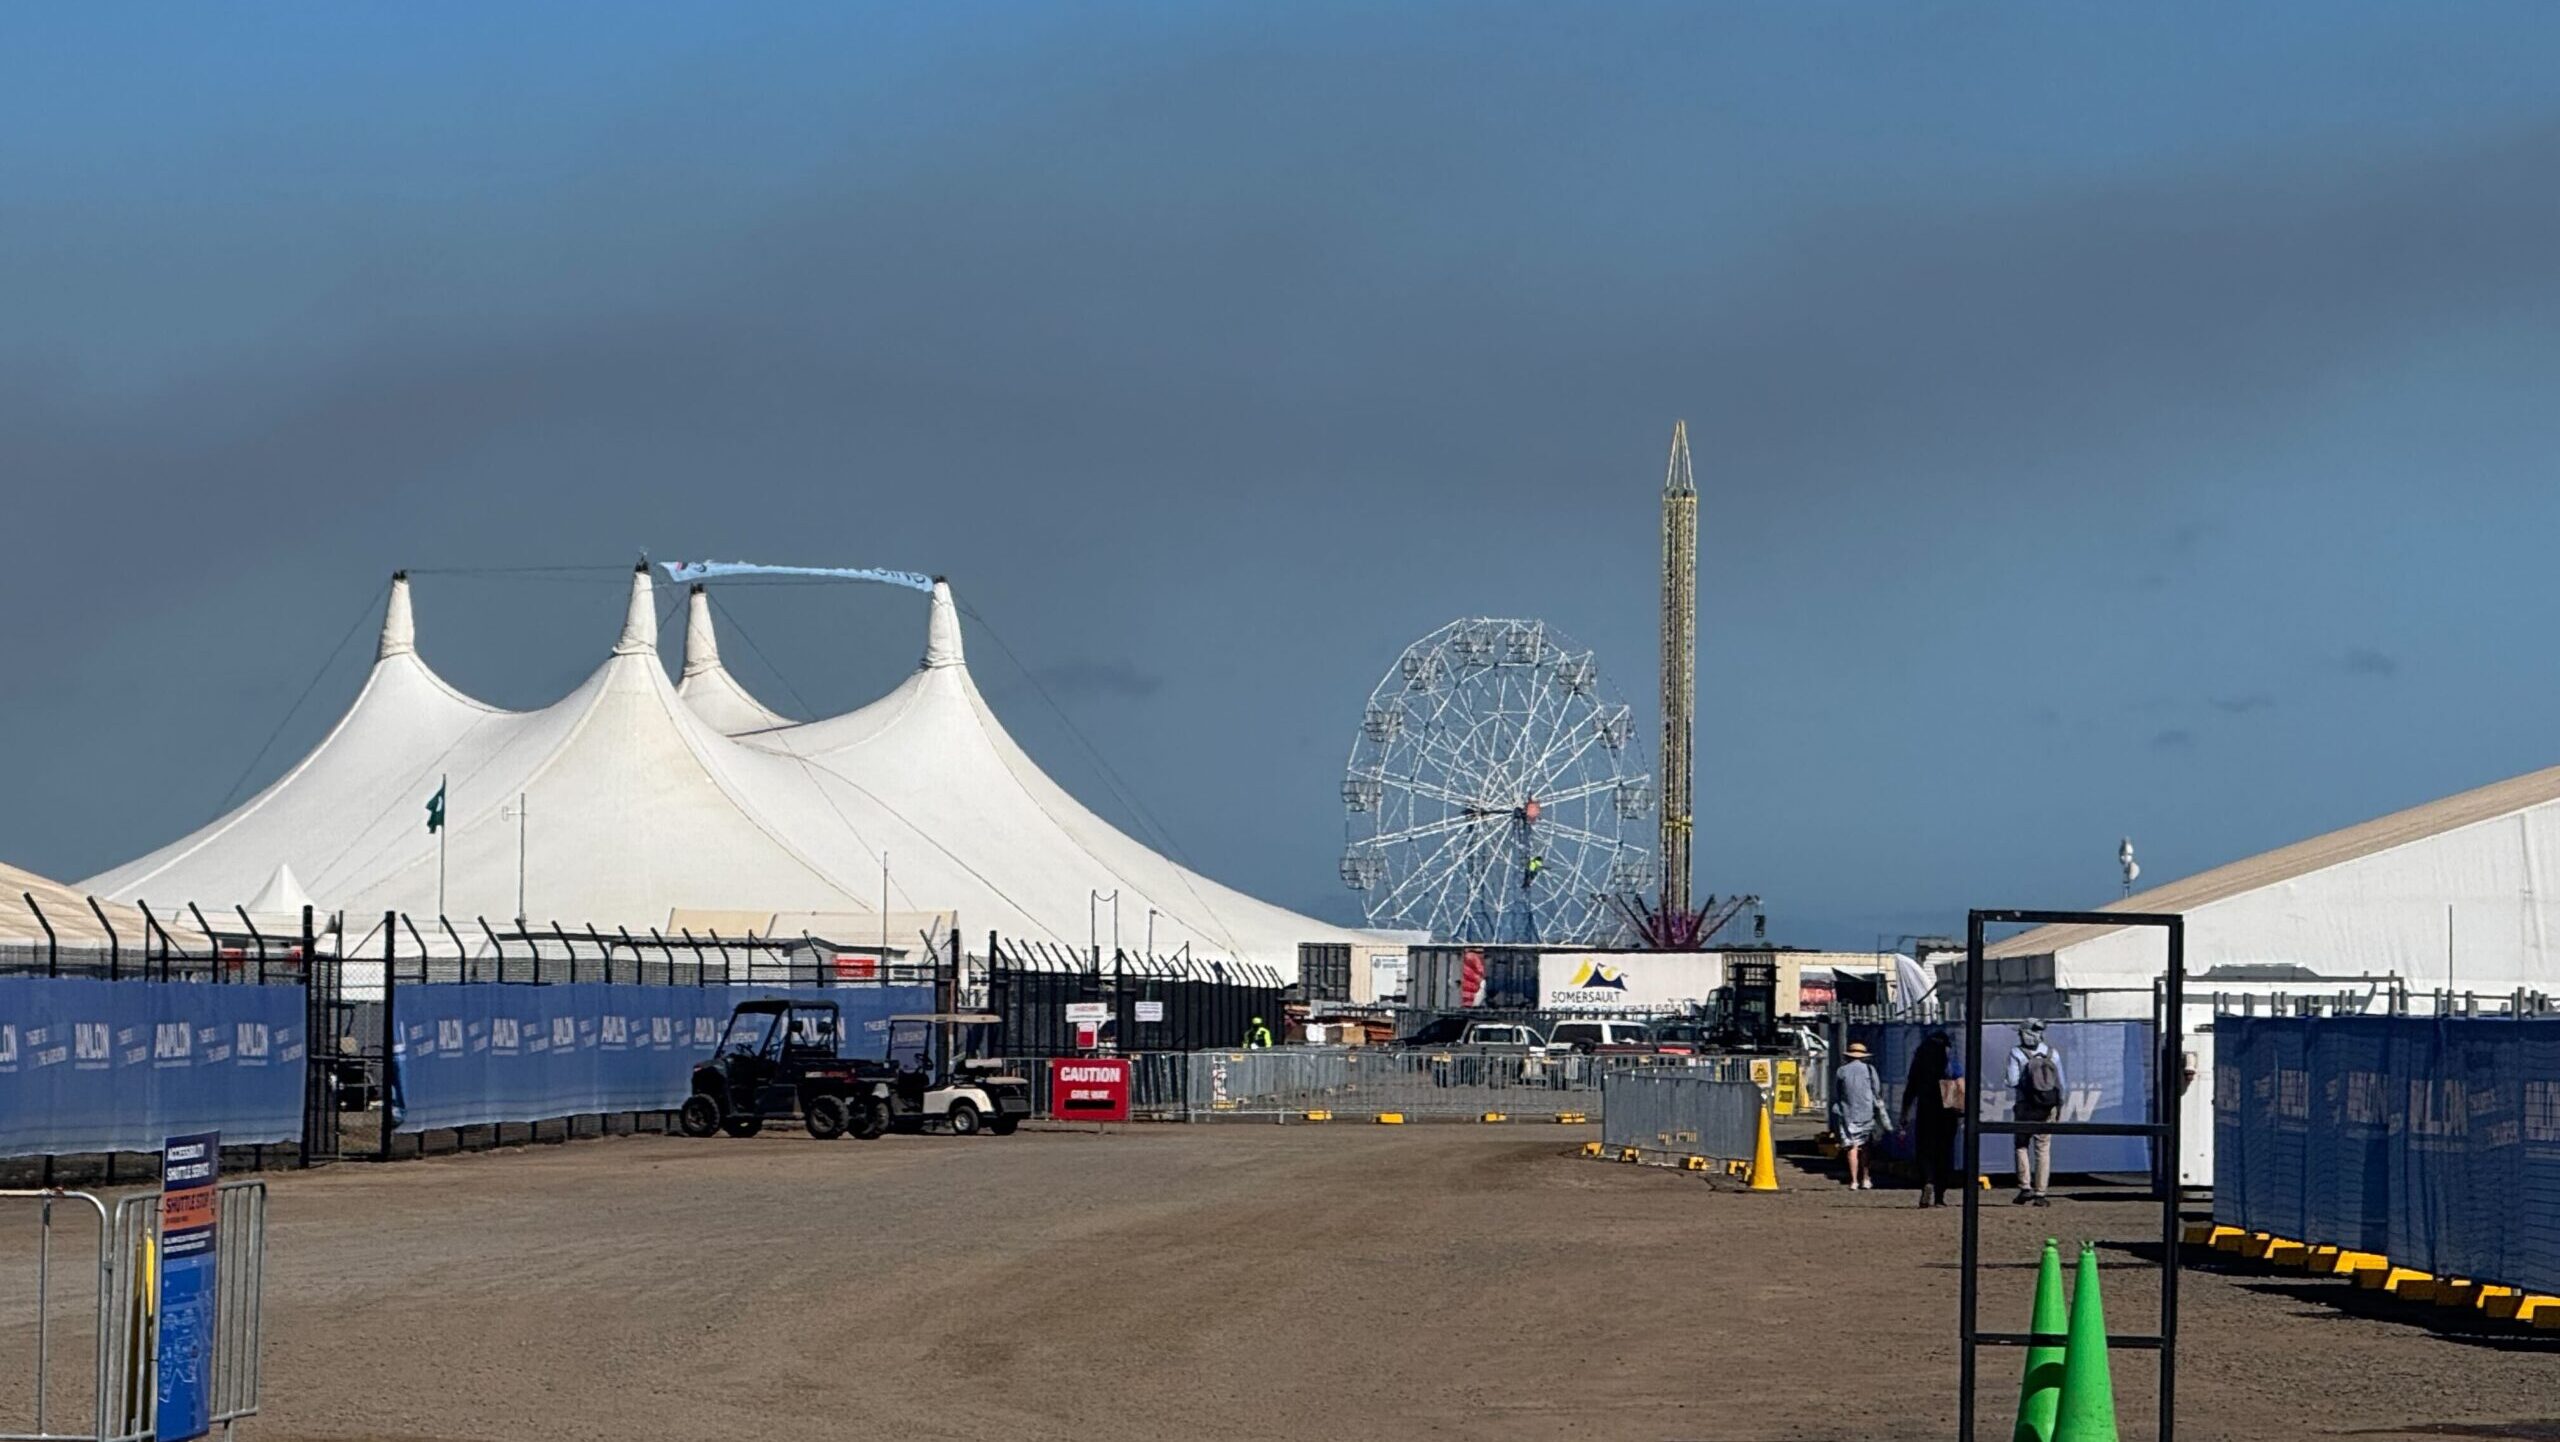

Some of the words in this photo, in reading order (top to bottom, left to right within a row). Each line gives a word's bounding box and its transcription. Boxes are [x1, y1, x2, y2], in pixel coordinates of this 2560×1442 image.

[1551, 991, 1621, 1004] SOMERSAULT
[1060, 1067, 1121, 1082] CAUTION
[166, 1195, 195, 1214] SHUTTLE
[195, 1191, 210, 1210] STOP
